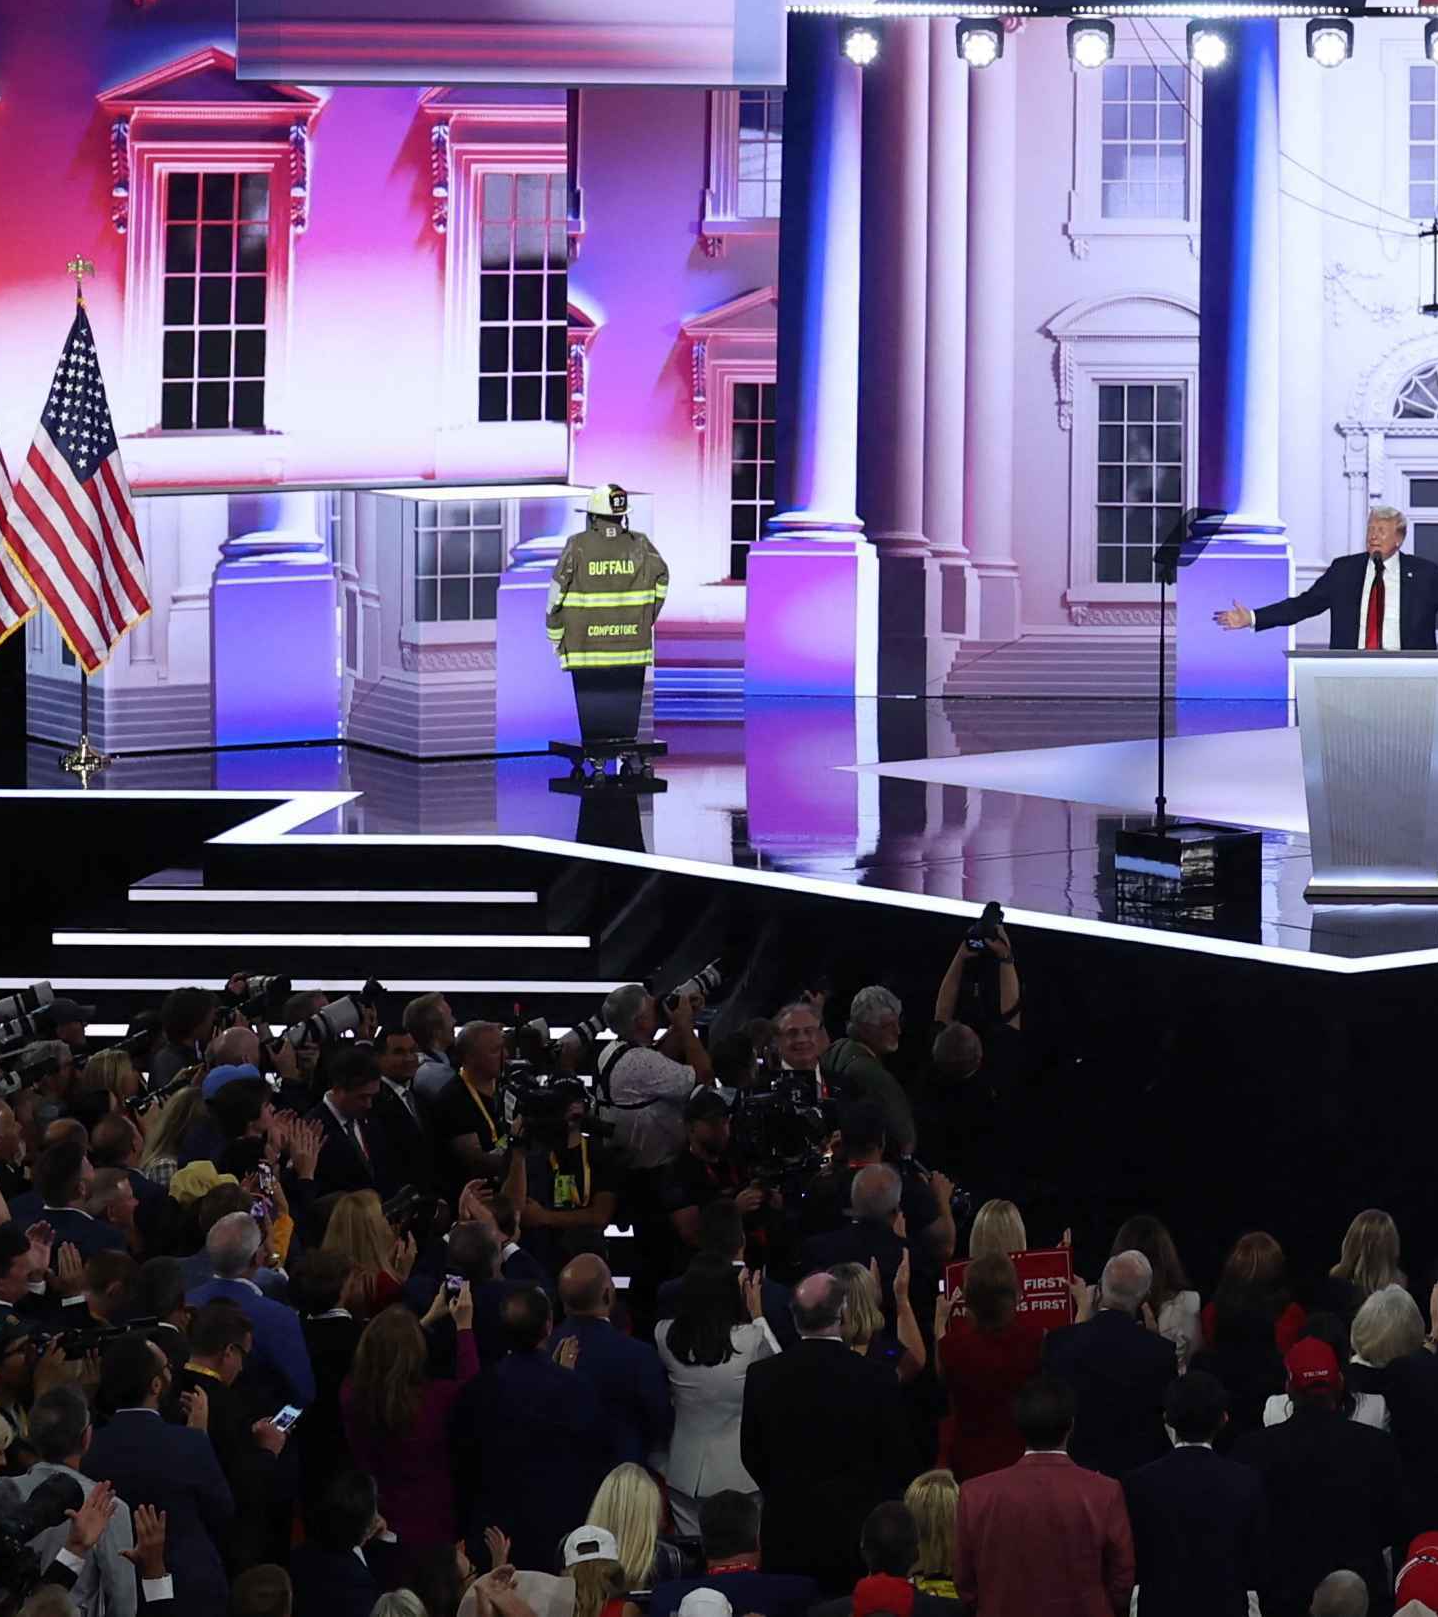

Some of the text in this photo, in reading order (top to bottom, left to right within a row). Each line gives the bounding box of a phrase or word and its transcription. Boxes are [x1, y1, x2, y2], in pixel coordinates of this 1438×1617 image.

[588, 559, 635, 575] BUFFALO
[1024, 1276, 1068, 1291] FIRST
[1031, 1299, 1068, 1312] FIRST
